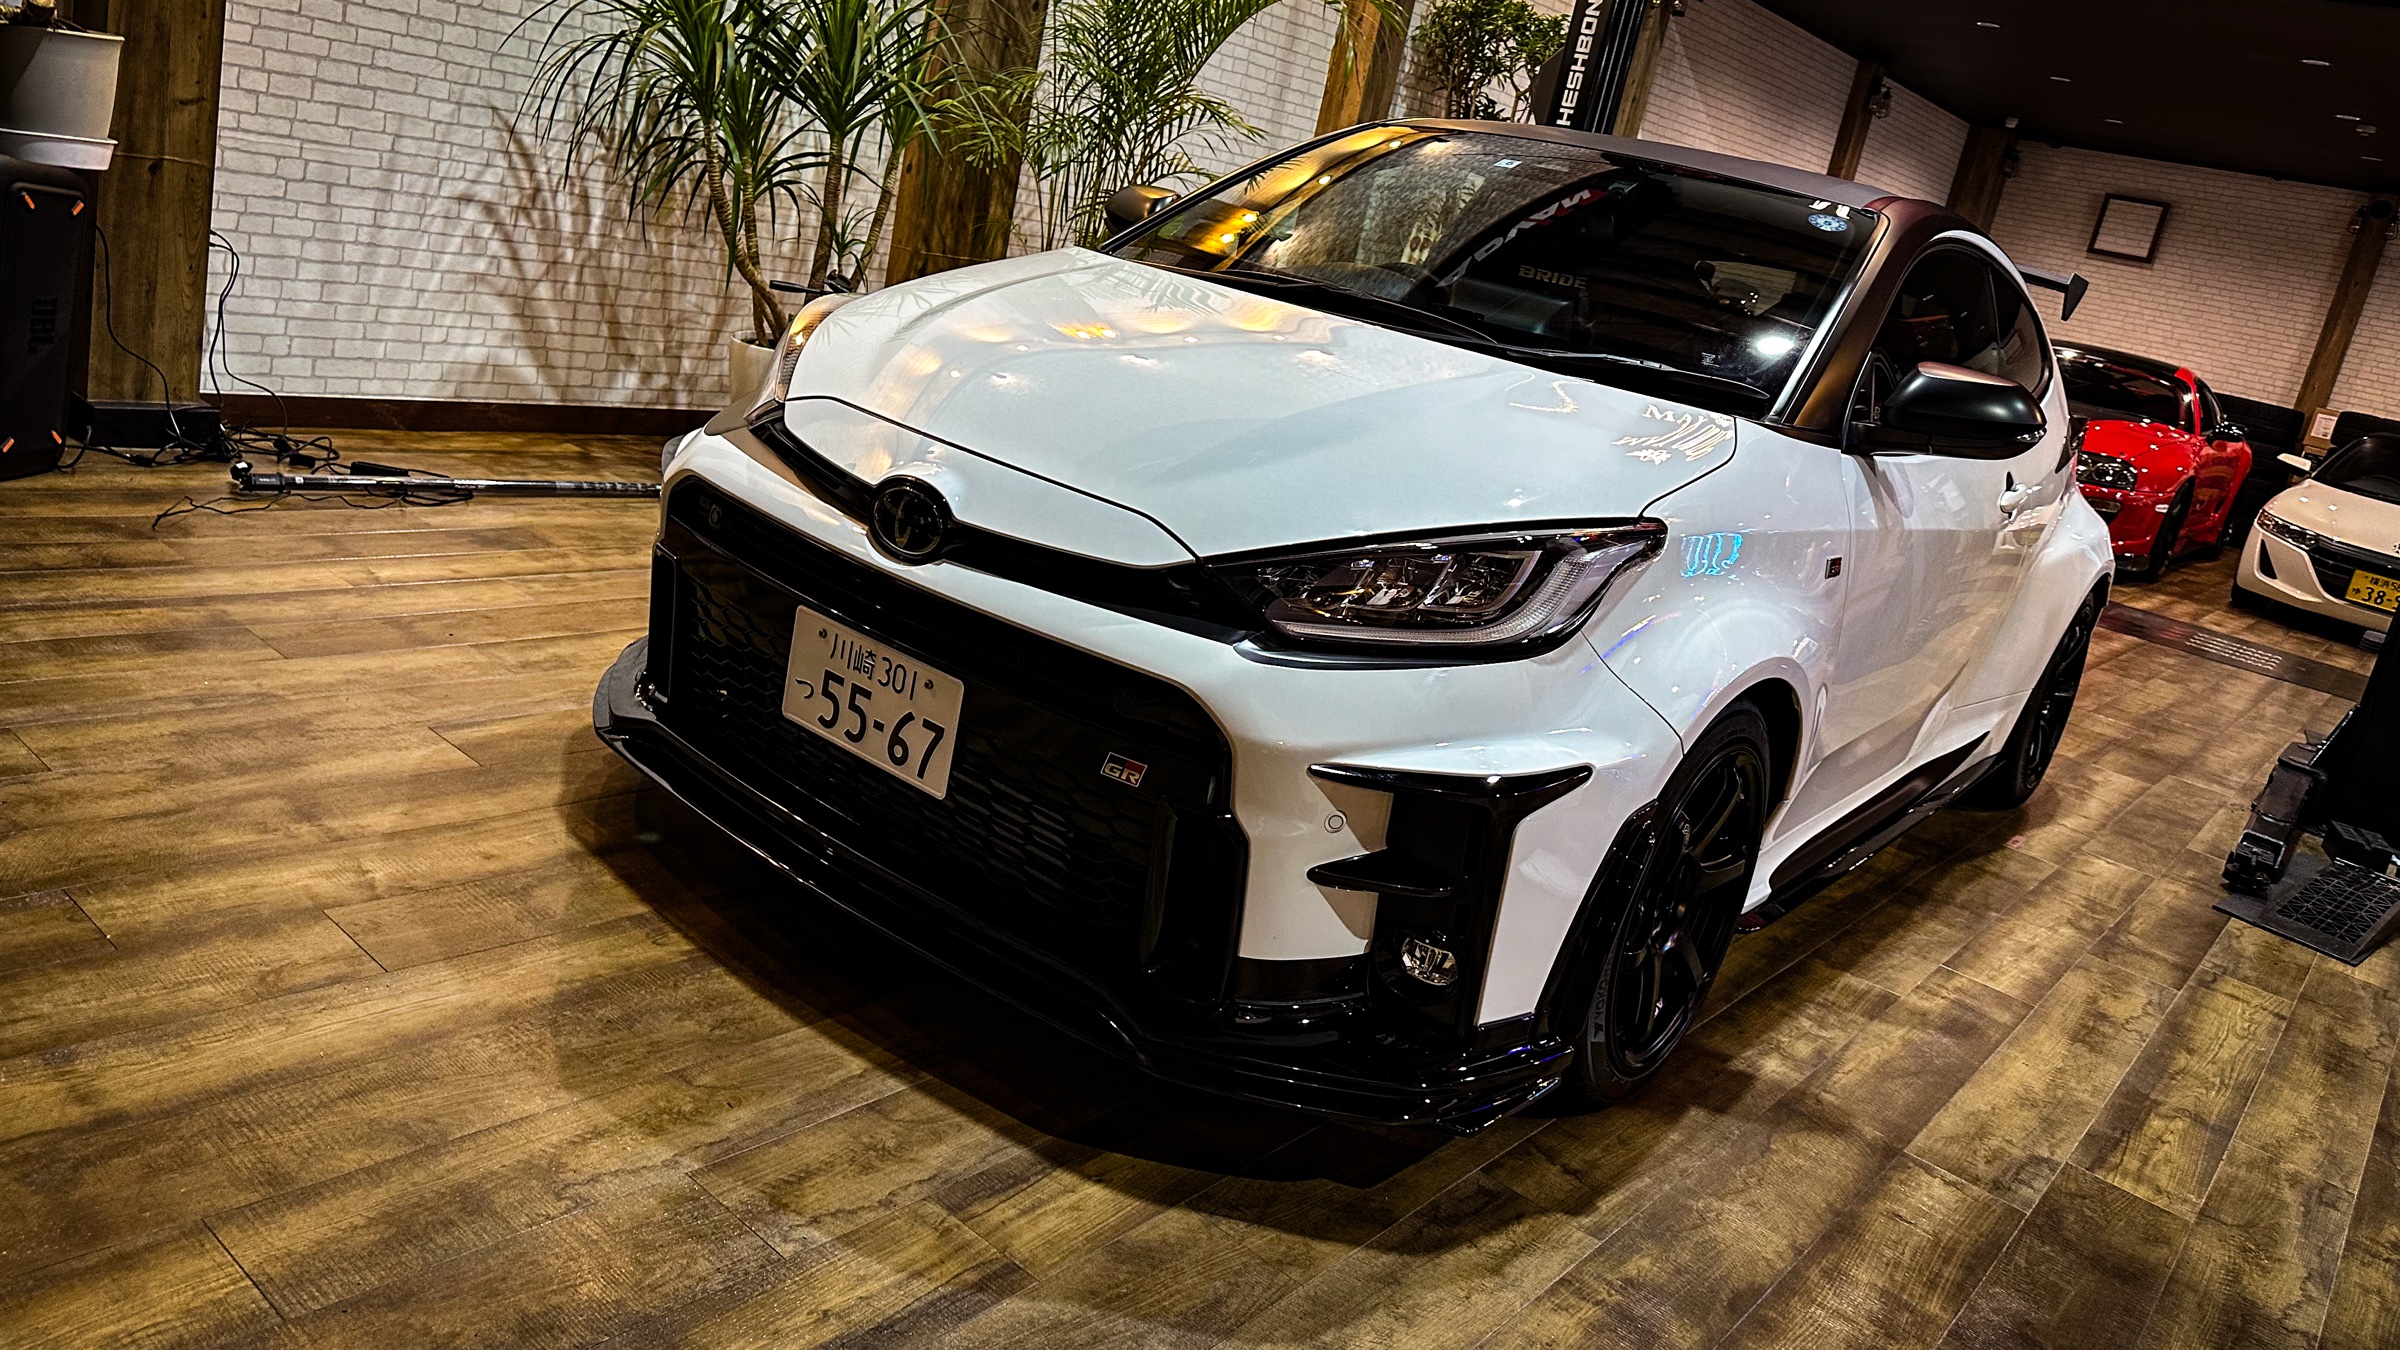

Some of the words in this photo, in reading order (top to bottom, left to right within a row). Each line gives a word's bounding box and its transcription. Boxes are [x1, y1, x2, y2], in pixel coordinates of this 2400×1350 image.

[1556, 0, 1604, 126] HESHBON
[1518, 264, 1588, 289] BRIDE
[28, 297, 58, 353] JBL
[830, 633, 918, 701] 川崎301
[795, 678, 814, 699] つ
[817, 668, 946, 780] 55-67
[1104, 763, 1140, 784] GR
